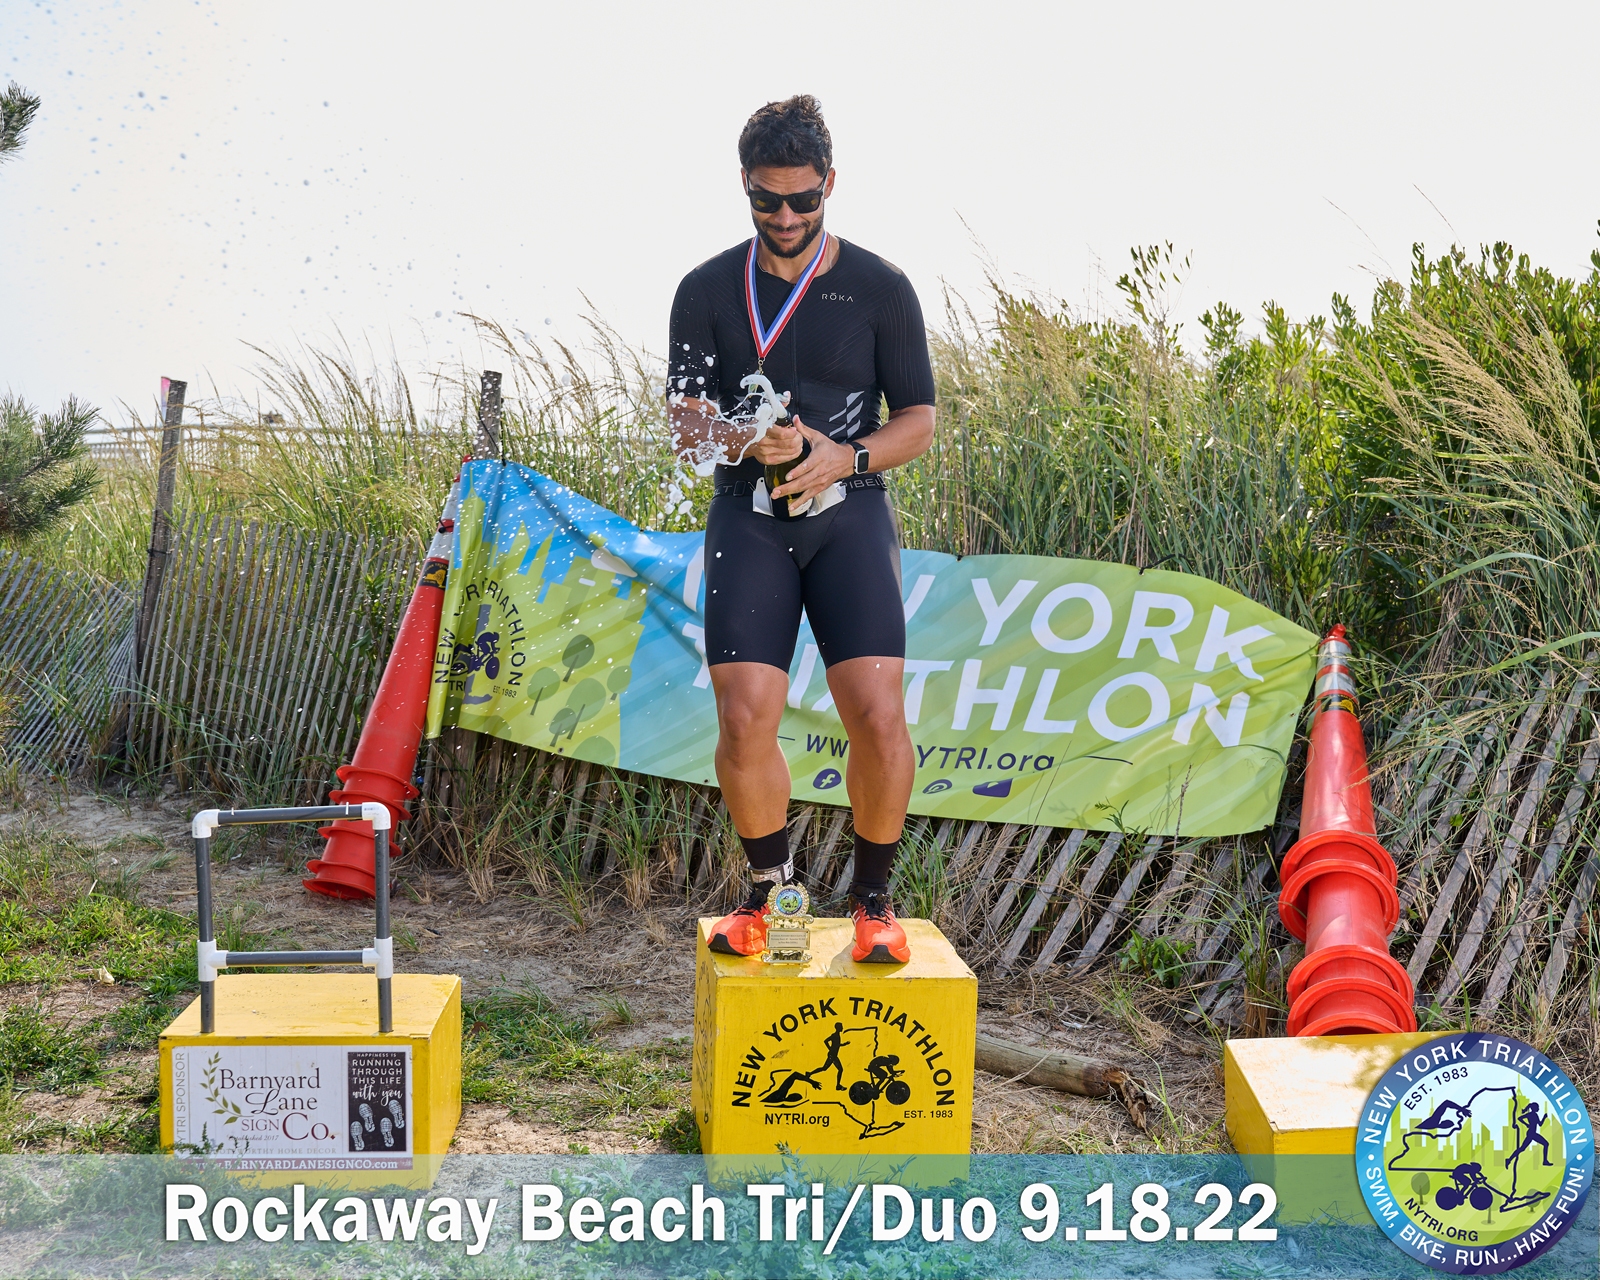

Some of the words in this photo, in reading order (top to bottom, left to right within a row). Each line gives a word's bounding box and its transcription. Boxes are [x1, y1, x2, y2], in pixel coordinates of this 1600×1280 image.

[971, 577, 1277, 682] YORK
[434, 628, 456, 684] NEW
[731, 1046, 766, 1108] NEW
[763, 997, 838, 1043] YORK
[849, 996, 955, 1106] TRIATHLON
[175, 1052, 186, 1112] SPONSOR
[219, 1067, 321, 1094] Barnyard
[245, 1089, 318, 1116] Lane
[352, 1084, 378, 1101] with
[381, 1089, 403, 1107] you
[241, 1118, 279, 1131] SIGN
[282, 1112, 336, 1141] Co.
[764, 1113, 830, 1128] NYTRI.org
[904, 1110, 926, 1118] EST.
[930, 1110, 953, 1118] 1983
[176, 1116, 186, 1146] YTRI
